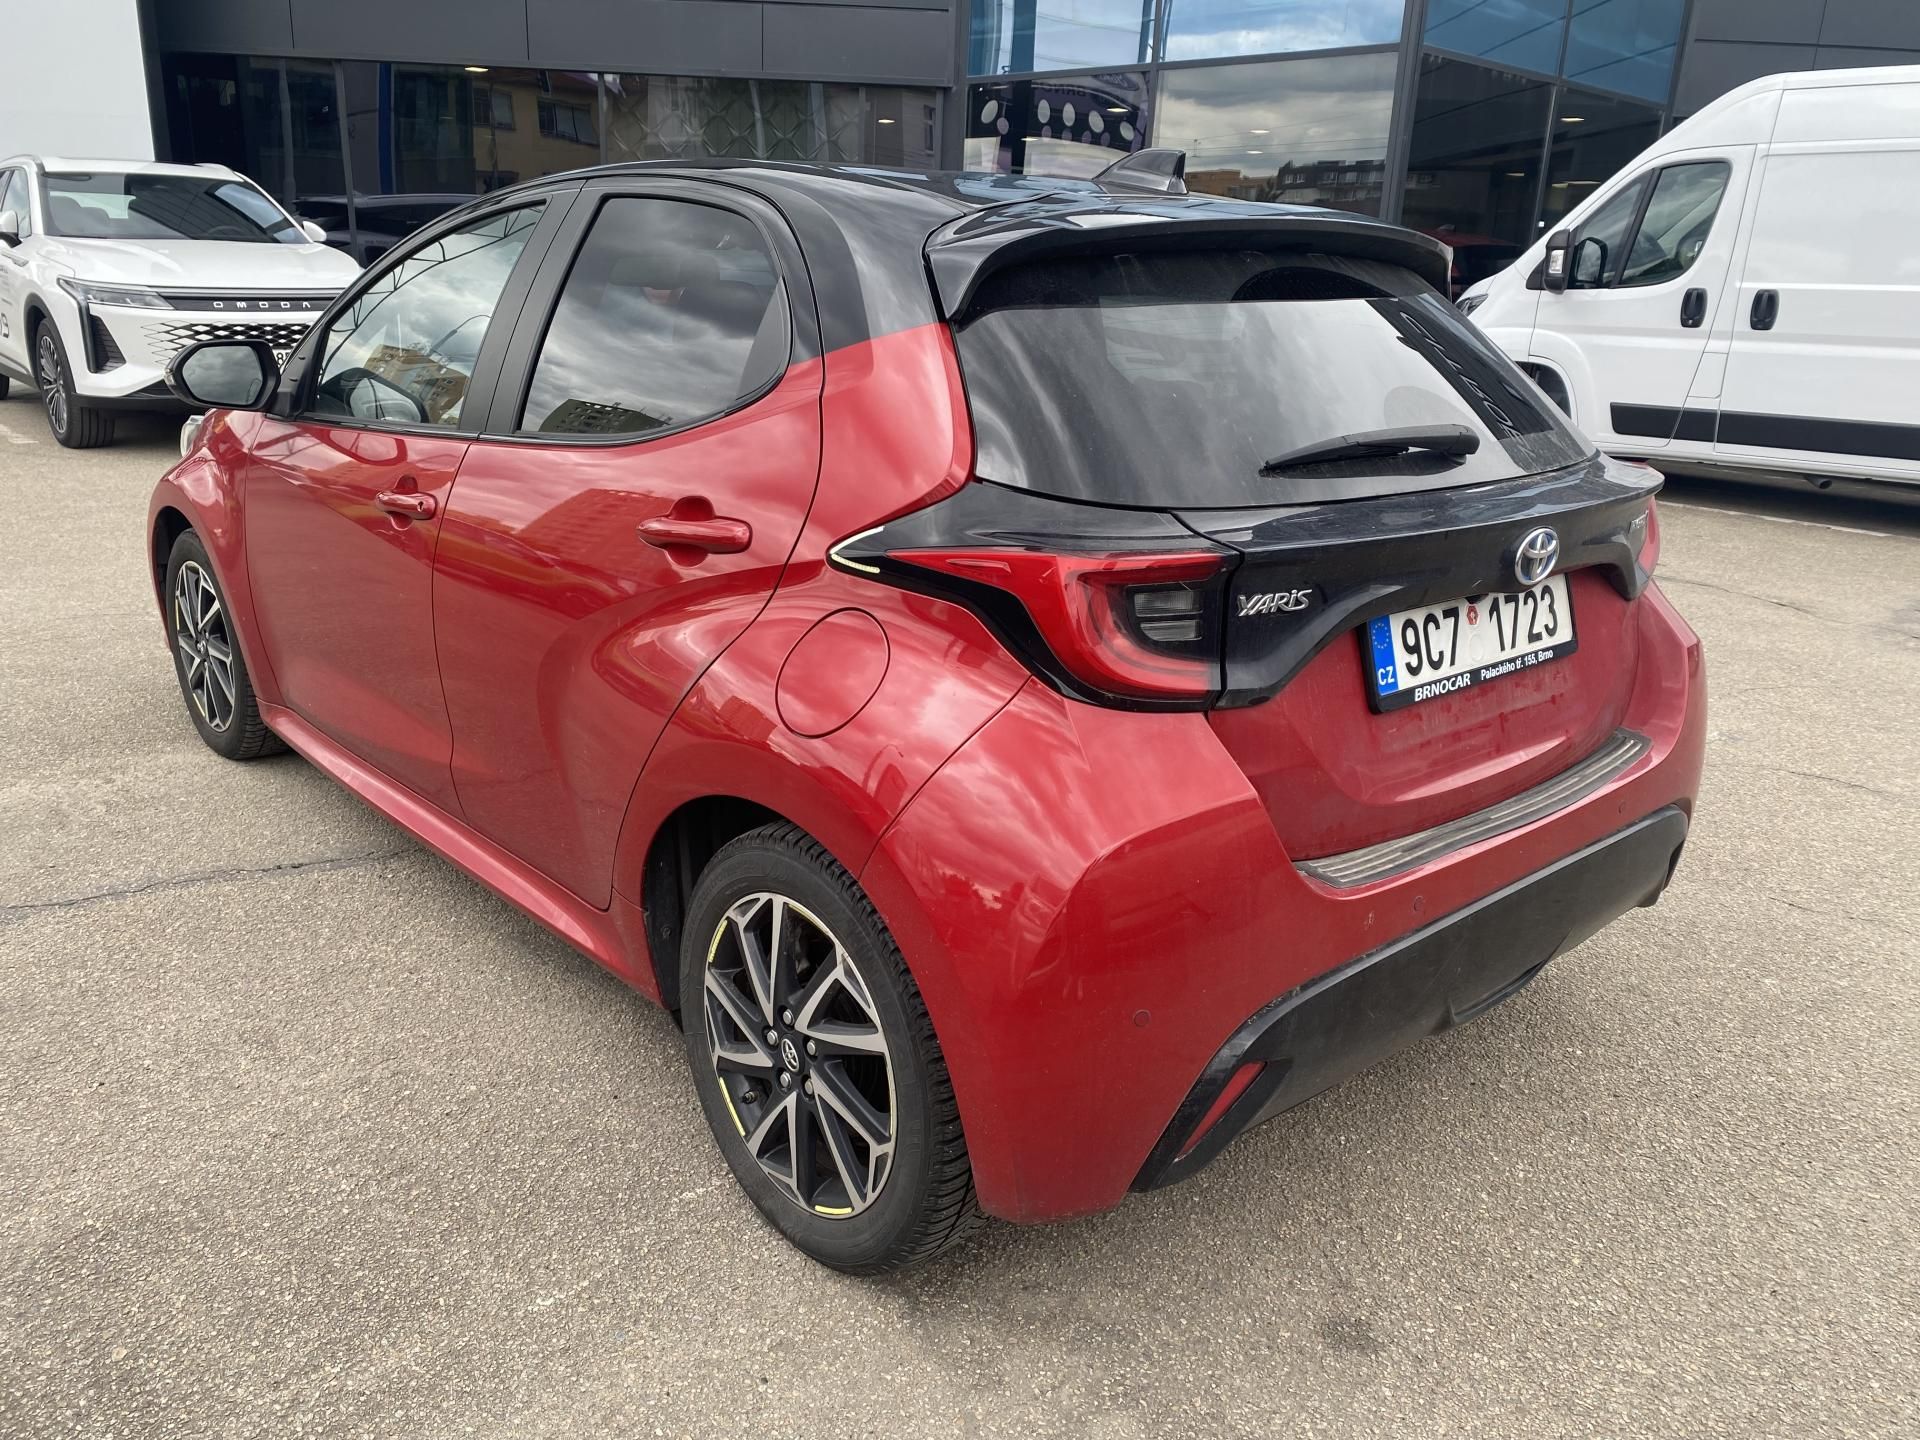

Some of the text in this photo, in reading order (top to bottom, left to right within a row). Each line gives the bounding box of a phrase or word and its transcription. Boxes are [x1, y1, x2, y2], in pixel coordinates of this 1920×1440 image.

[213, 301, 311, 309] OMODA
[1401, 585, 1559, 677] 9C7 1723
[1377, 665, 1395, 686] CZ
[1414, 672, 1471, 702] BRNOCAR
[1480, 661, 1515, 681] Palackého
[1524, 653, 1538, 665] 155,
[1537, 649, 1554, 662] Brno
